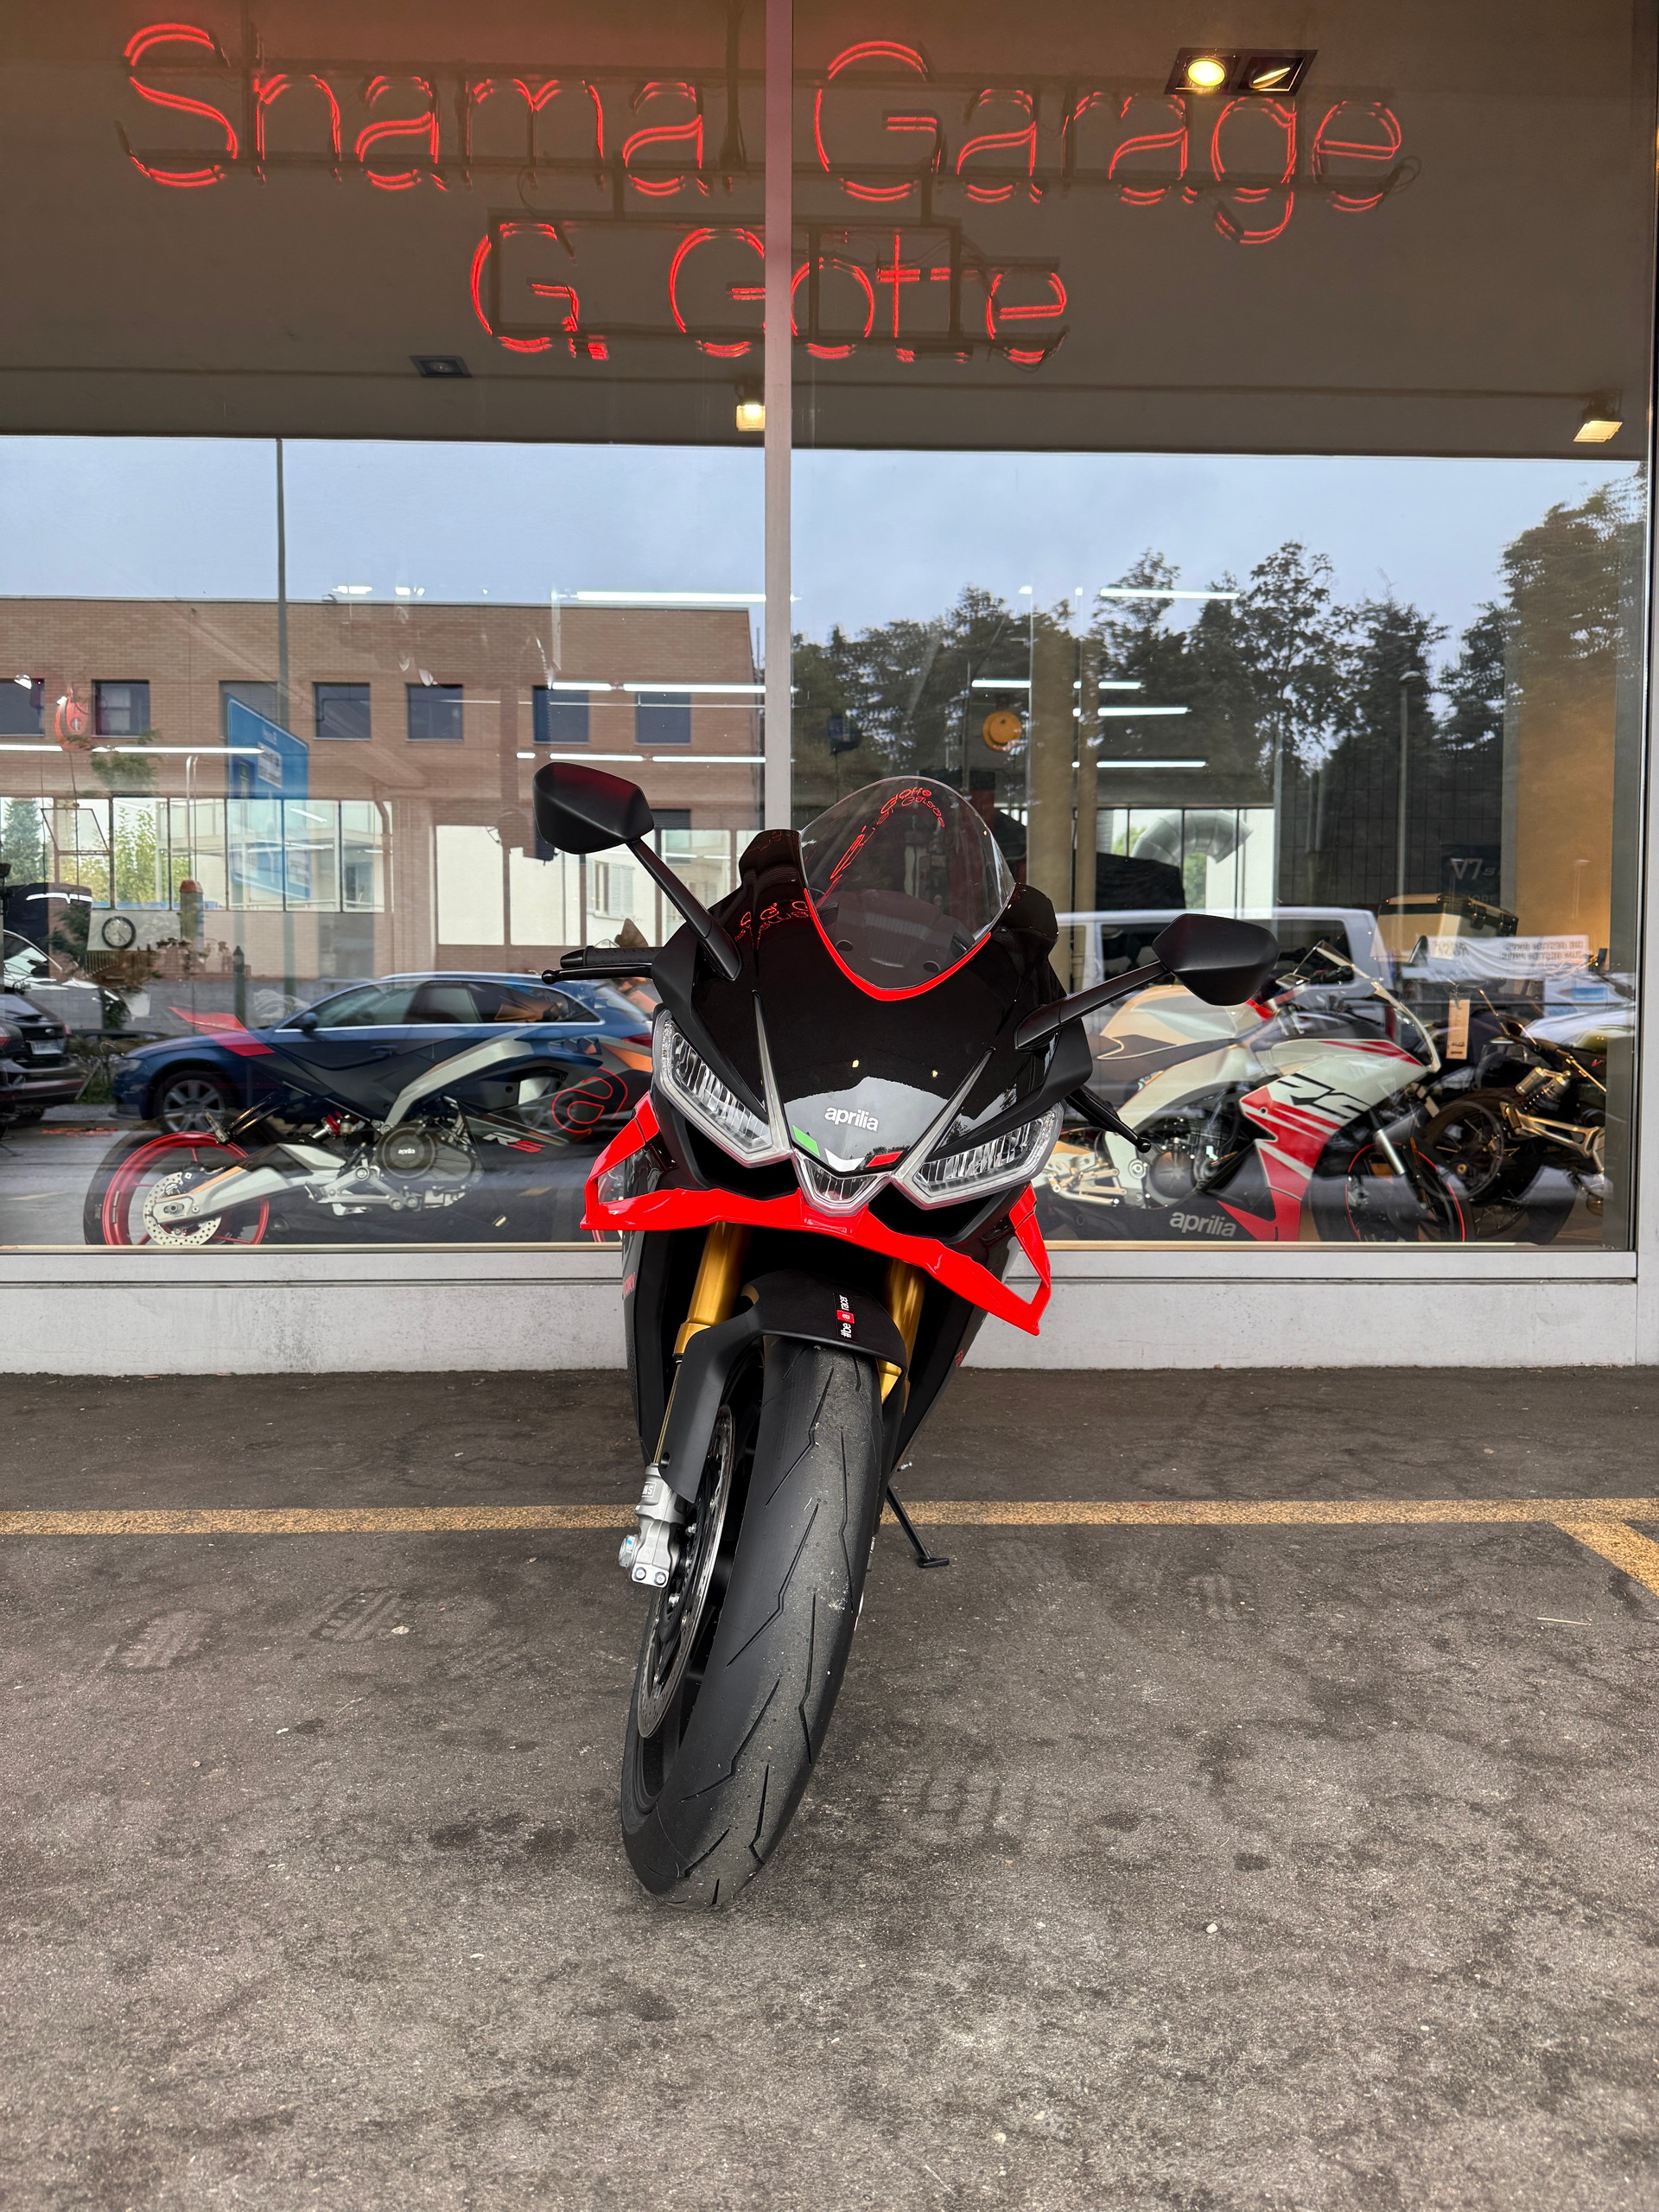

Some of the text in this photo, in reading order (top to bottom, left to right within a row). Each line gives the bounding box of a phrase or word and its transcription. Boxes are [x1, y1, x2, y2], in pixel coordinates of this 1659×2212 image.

[815, 41, 1404, 245] Garage
[824, 1107, 879, 1132] aprilia
[482, 1131, 548, 1154] RS
[1169, 1211, 1236, 1237] aprilia
[840, 1322, 852, 1338] #be
